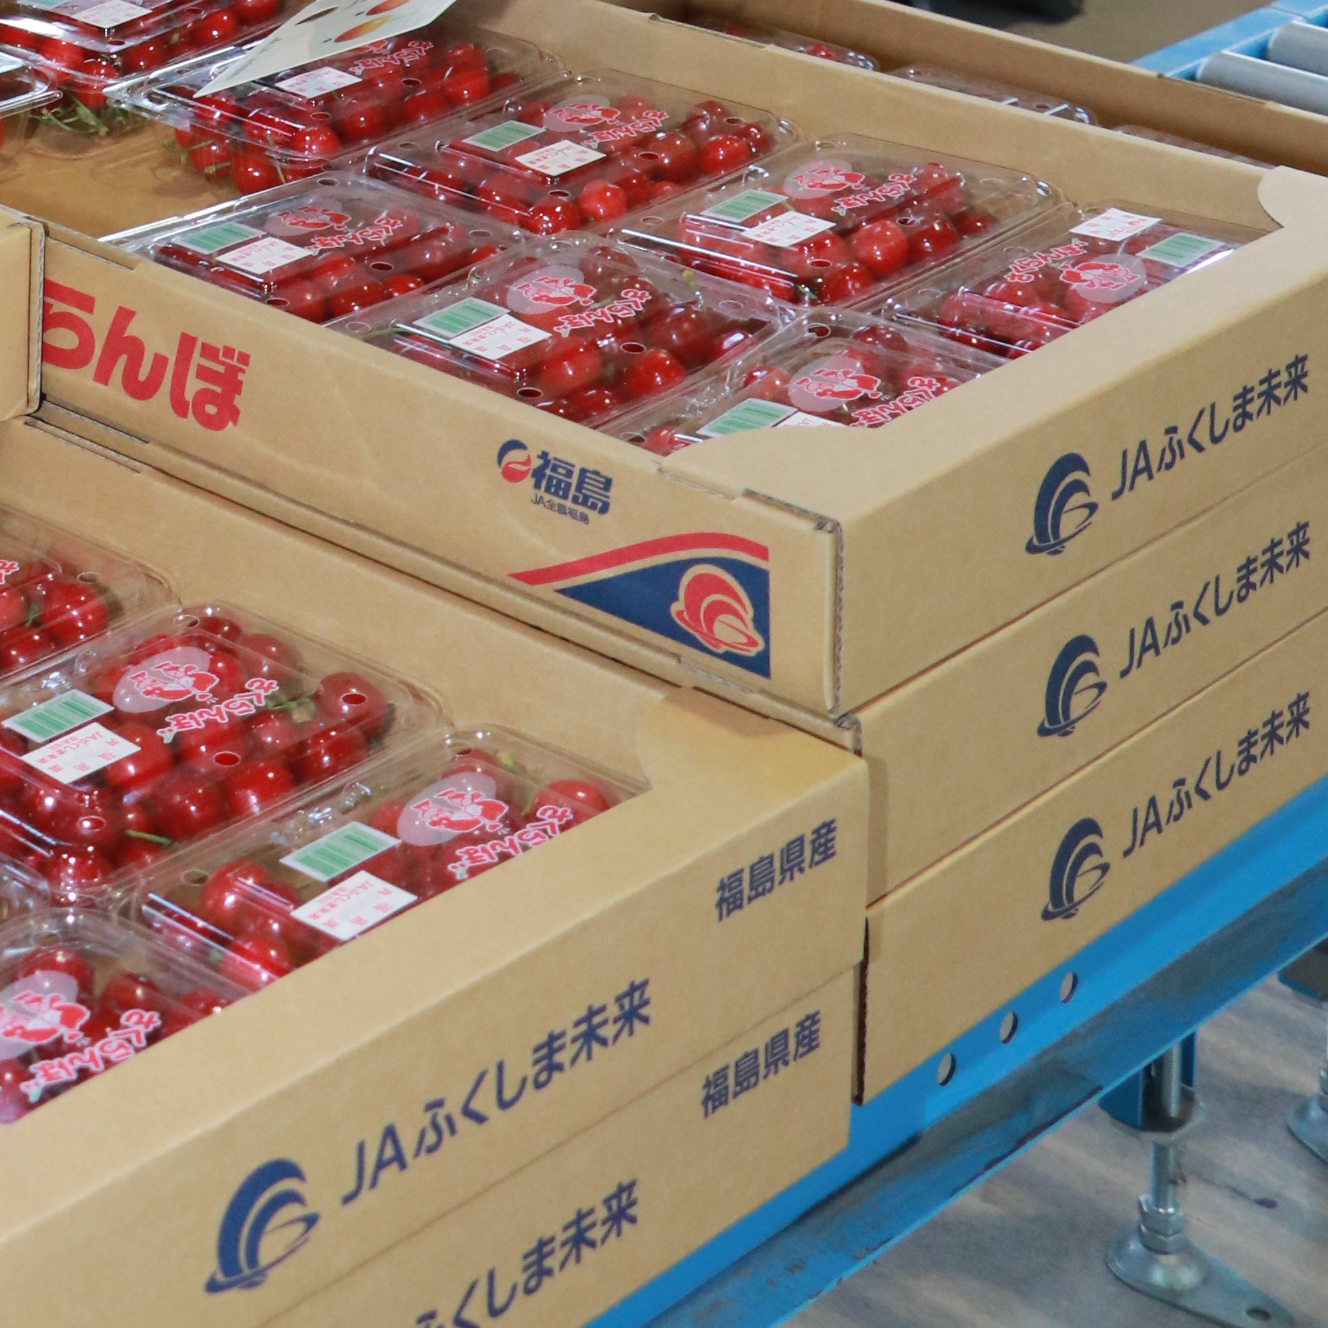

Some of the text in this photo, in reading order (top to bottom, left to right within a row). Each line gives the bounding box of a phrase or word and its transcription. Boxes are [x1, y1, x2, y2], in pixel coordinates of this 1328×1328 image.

[584, 109, 669, 145] さくらんぼ
[831, 171, 916, 213] さくらんぼ
[305, 217, 402, 252] さくらんぼ
[1004, 239, 1088, 283] さくらんぼ
[553, 288, 652, 334] さくらんぼ
[1112, 354, 1308, 501] JAふくしま未来
[531, 450, 612, 515] 福島
[1119, 521, 1311, 679] JAふくしま未来
[156, 677, 279, 740] さくらんぼ
[1122, 691, 1311, 859] JAふくしま未来
[447, 804, 574, 876] さくらんぼ
[715, 819, 838, 922] 福島県産
[19, 1008, 161, 1100] さくらんぼ
[700, 1010, 822, 1119] 福島県産
[341, 977, 653, 1206] JAふくしま未来
